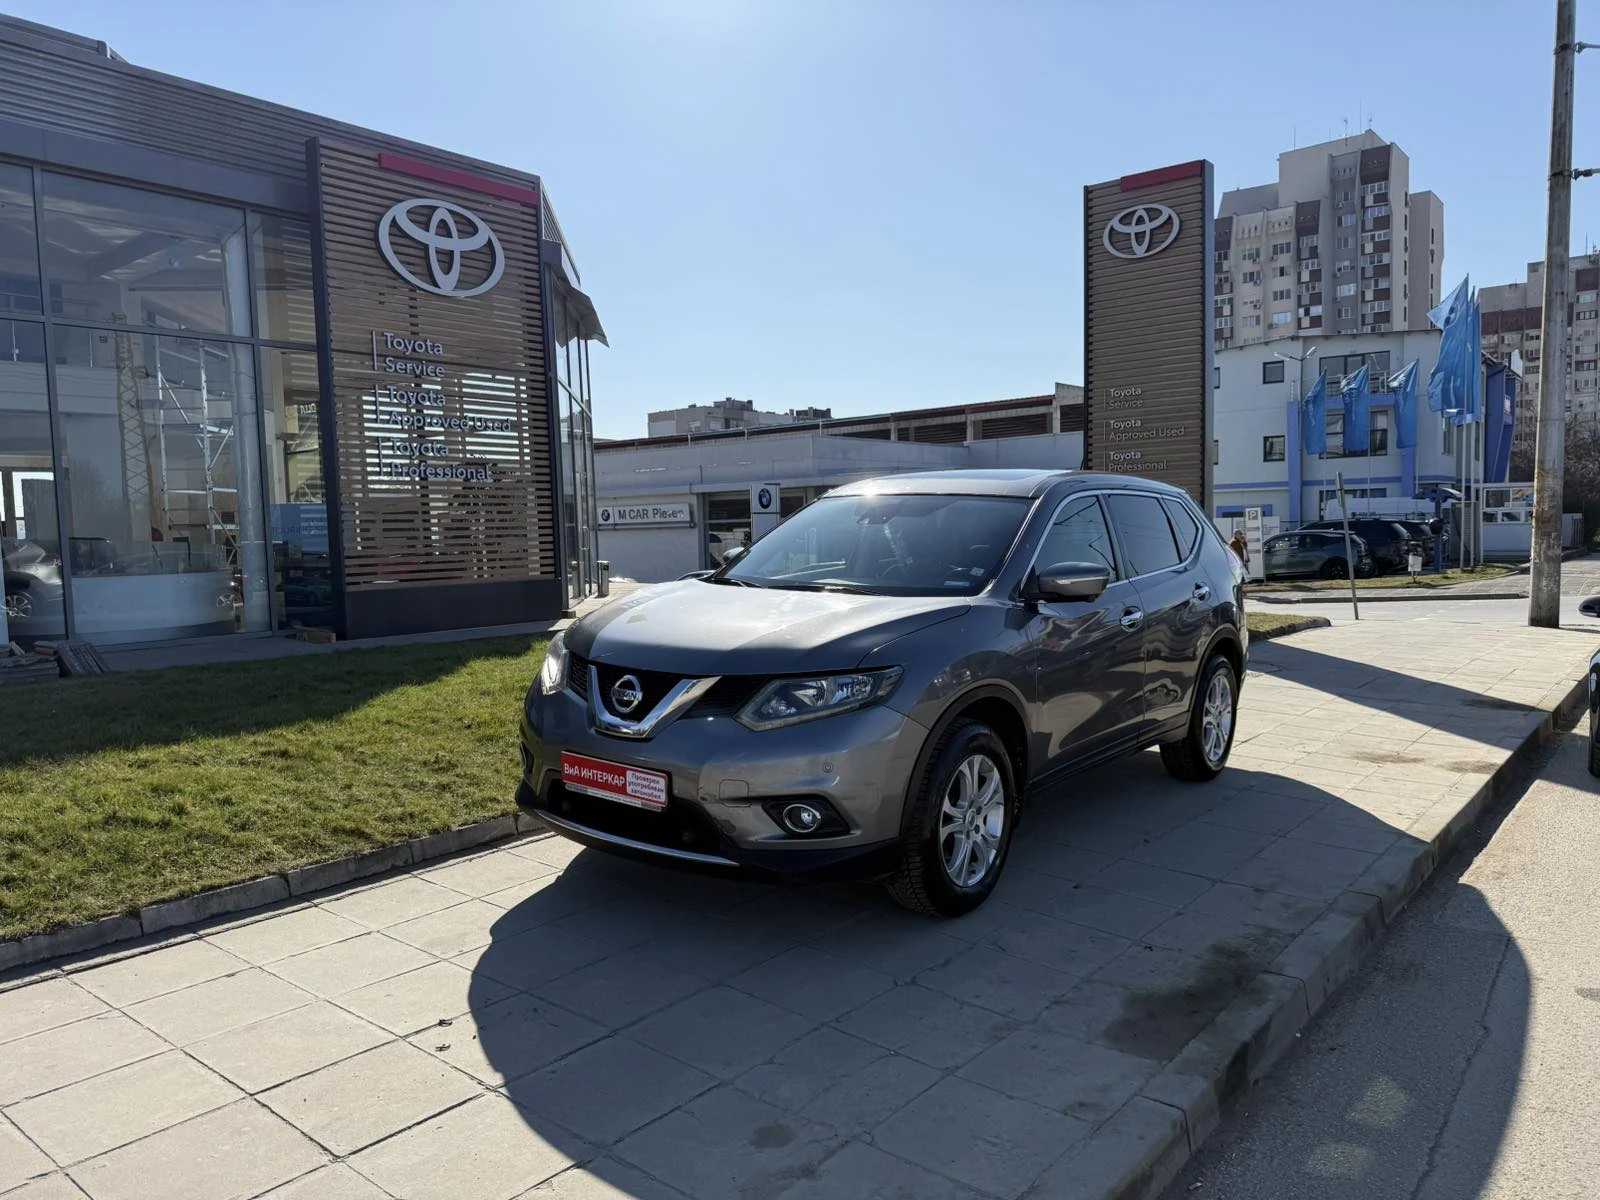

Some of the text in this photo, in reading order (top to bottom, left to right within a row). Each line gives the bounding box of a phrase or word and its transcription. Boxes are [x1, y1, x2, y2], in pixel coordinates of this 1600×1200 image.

[383, 331, 443, 355] Toyota
[385, 357, 445, 377] Service
[387, 385, 446, 407] Toyota
[1109, 387, 1142, 399] Toyota
[1108, 399, 1144, 409] Service
[389, 411, 511, 432] Approved Used
[1109, 419, 1142, 431] Toyota
[1109, 426, 1185, 443] Approved Used
[390, 438, 449, 458] Toyota
[1108, 450, 1142, 462] Toyota
[391, 461, 490, 480] Professional
[1108, 460, 1168, 472] Professional
[618, 507, 685, 521] M CAR Pleven
[1249, 510, 1257, 520] P
[580, 767, 626, 786] ИНТЕРКАР
